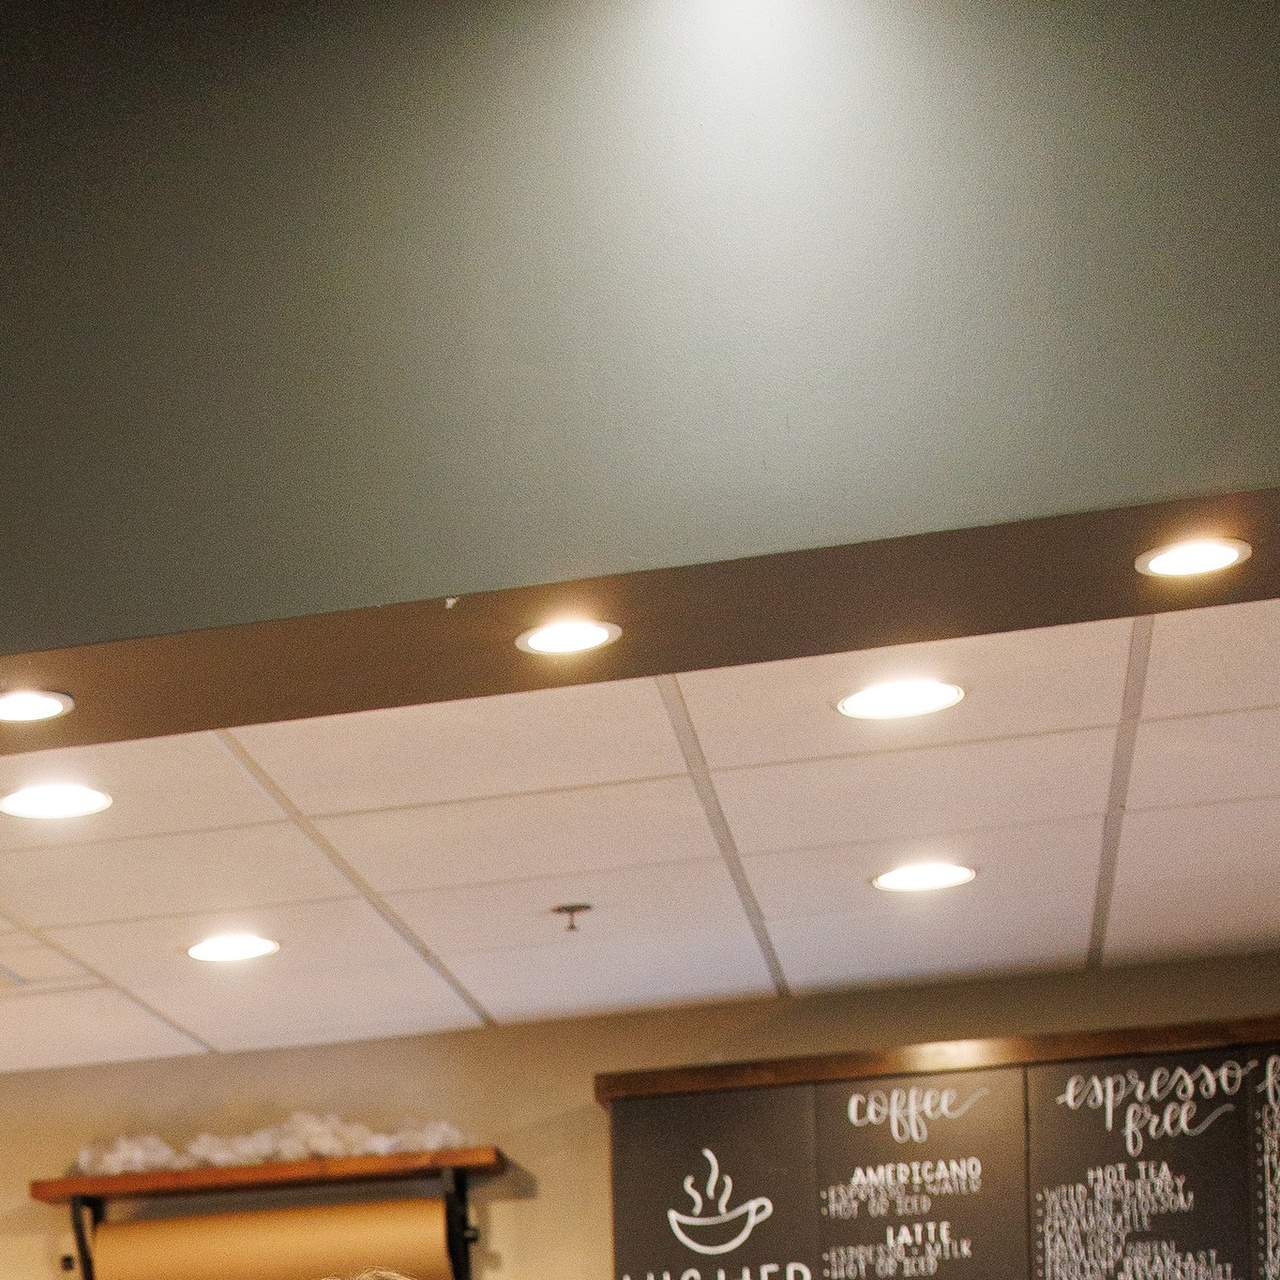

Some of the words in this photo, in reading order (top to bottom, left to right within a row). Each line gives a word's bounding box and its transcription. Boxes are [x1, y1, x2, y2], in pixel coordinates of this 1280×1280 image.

[847, 1087, 990, 1143] coffee
[1056, 1059, 1258, 1132] espresso
[1125, 1100, 1234, 1157] free
[850, 1156, 982, 1186] AMERICANO
[1086, 1162, 1127, 1187] HOT
[886, 1221, 951, 1246] LATTE
